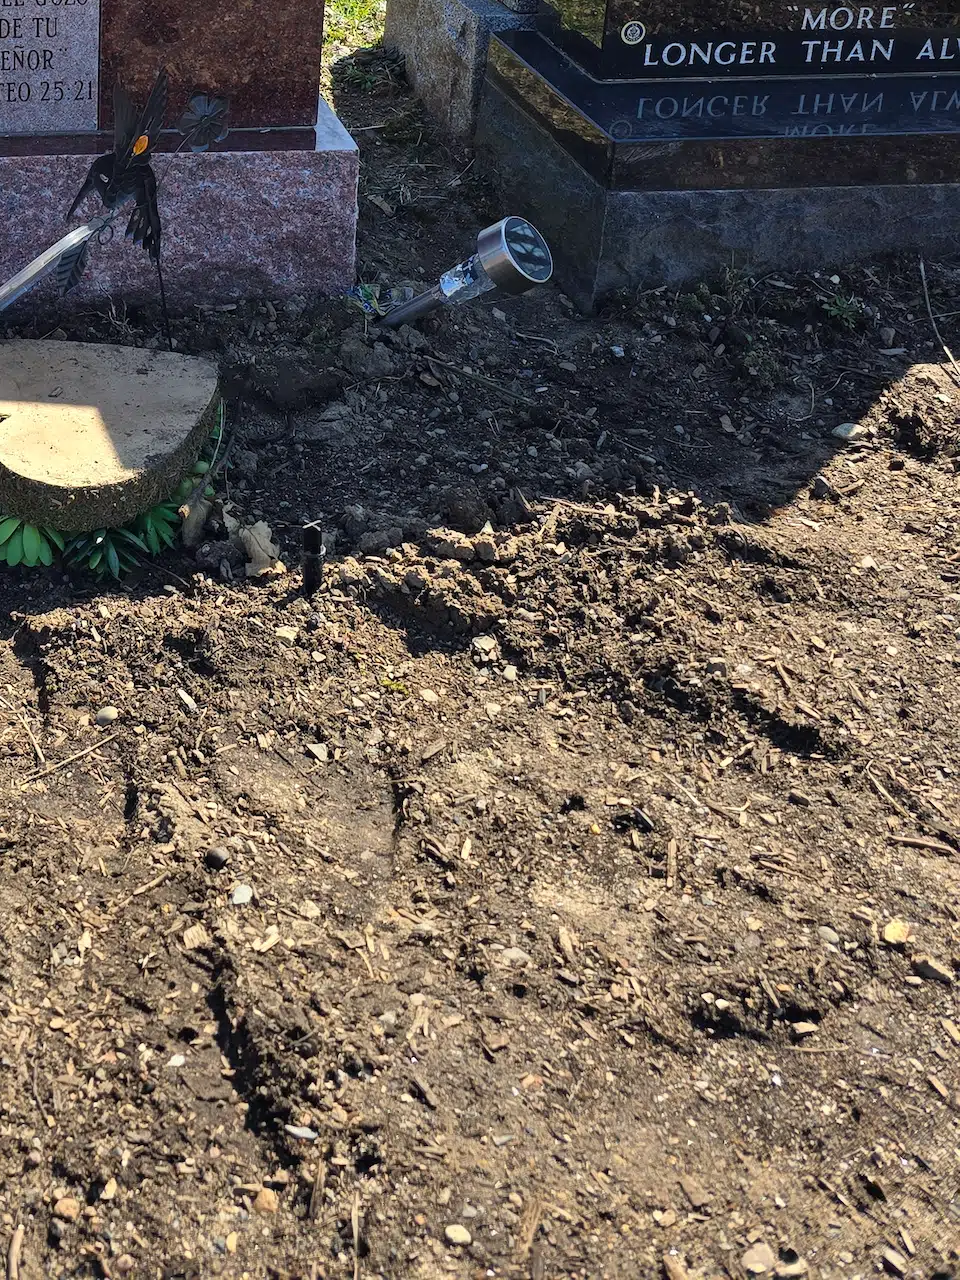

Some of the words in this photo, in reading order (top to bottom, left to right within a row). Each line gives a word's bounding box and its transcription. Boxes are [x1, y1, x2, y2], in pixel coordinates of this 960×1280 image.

[31, 17, 59, 38] TU
[643, 41, 778, 67] LONGER
[801, 38, 896, 63] THAN
[915, 37, 960, 61] AL
[40, 80, 94, 102] 25:21
